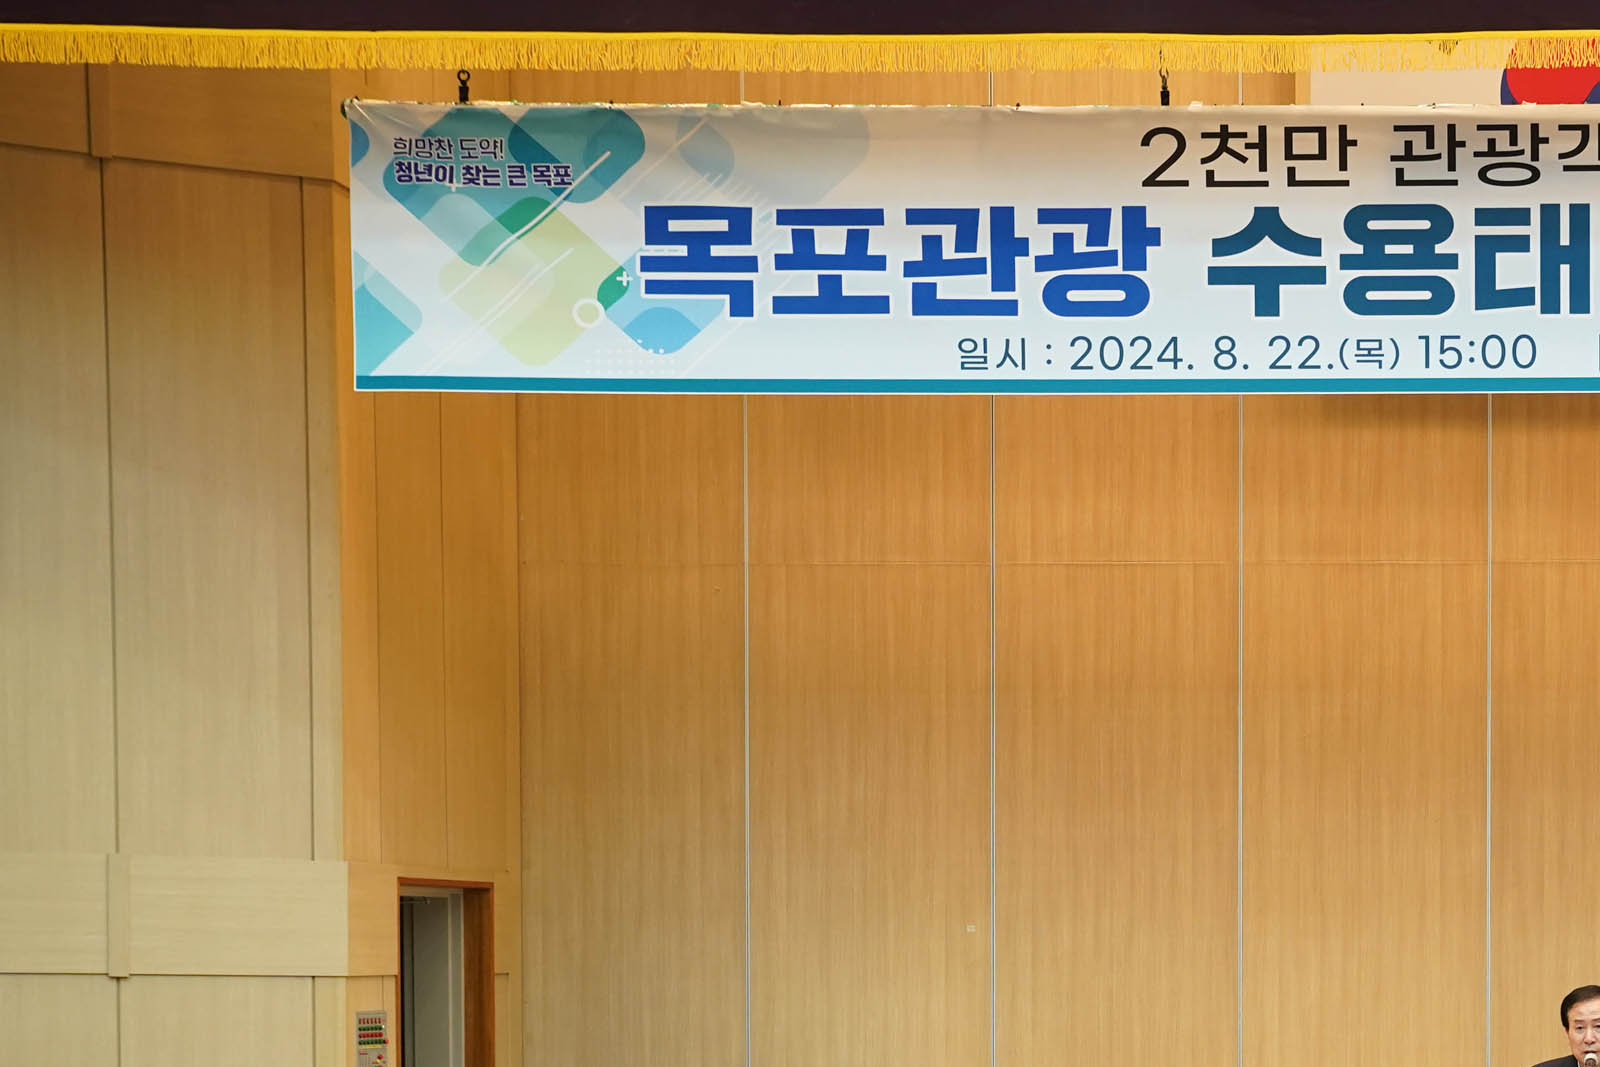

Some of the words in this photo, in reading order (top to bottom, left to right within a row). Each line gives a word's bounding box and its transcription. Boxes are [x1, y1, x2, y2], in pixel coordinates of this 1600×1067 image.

[393, 137, 454, 159] 희망찬
[459, 138, 504, 160] 도약!
[1140, 123, 1358, 188] 2천만
[394, 160, 455, 184] 청년이
[461, 164, 502, 187] 찾는
[506, 164, 528, 187] 큰
[532, 163, 575, 187] 목포
[638, 204, 1162, 319] 목포관광
[957, 337, 1026, 371] 일시
[1069, 335, 1195, 371] 2024.
[1213, 335, 1250, 371] 8.
[1418, 334, 1537, 370] 15:00
